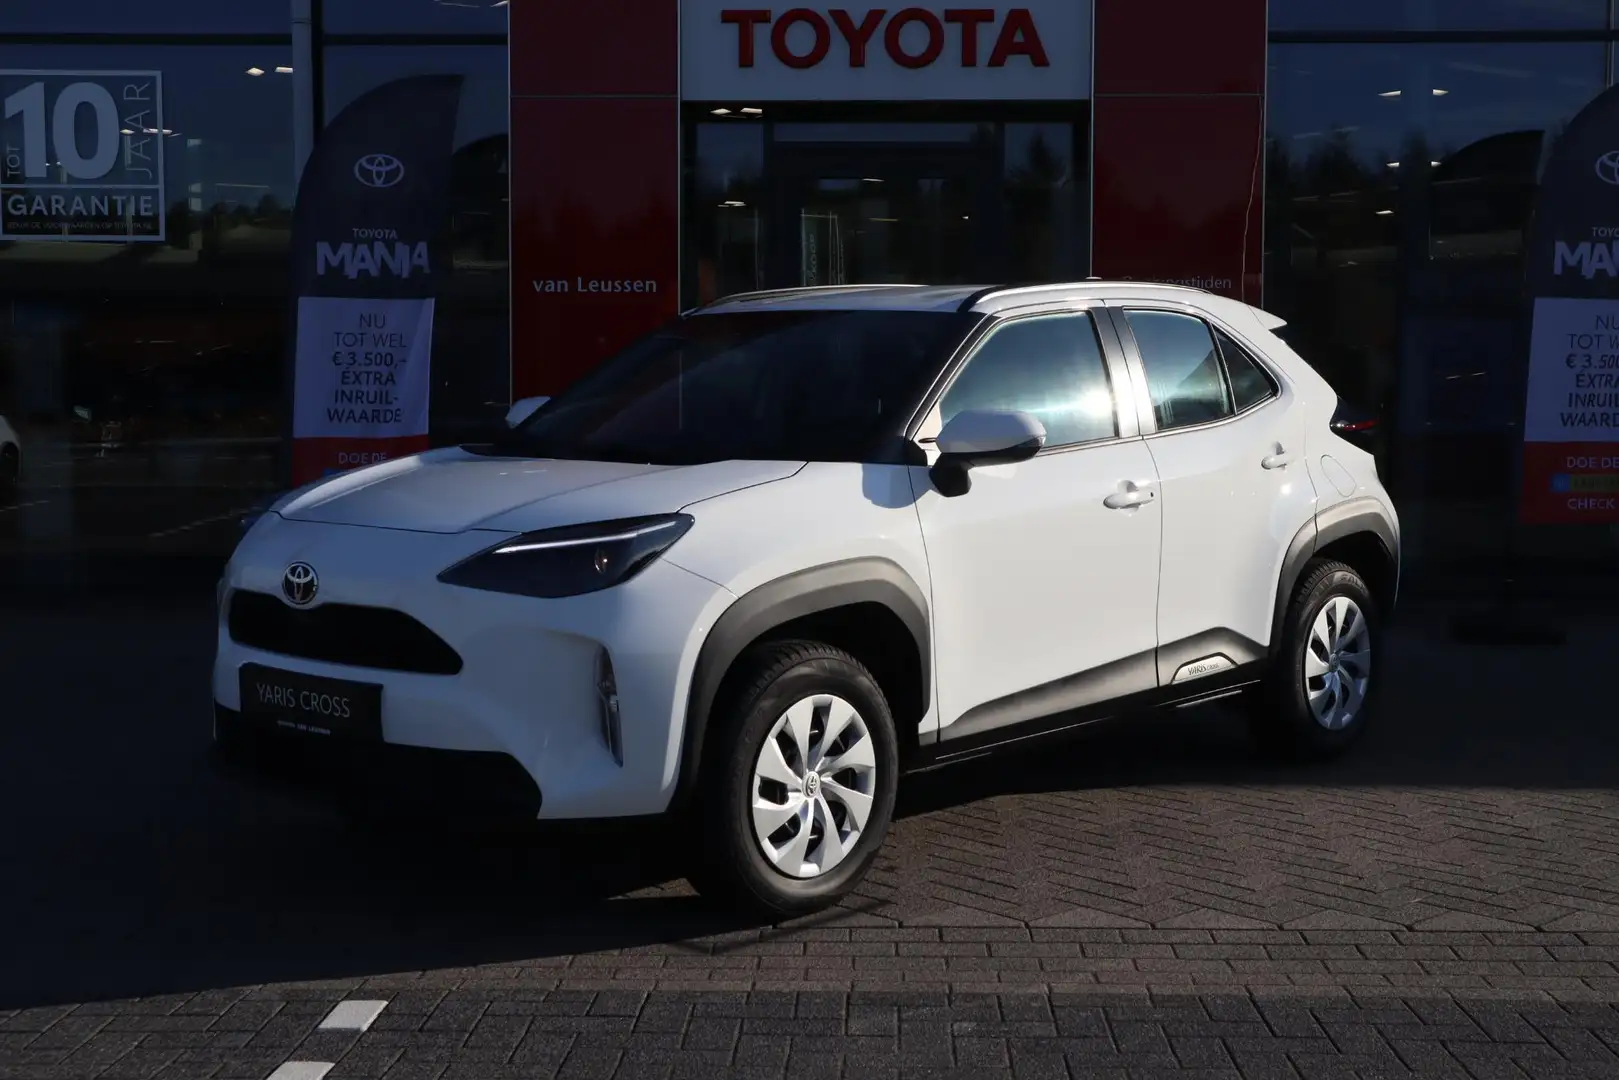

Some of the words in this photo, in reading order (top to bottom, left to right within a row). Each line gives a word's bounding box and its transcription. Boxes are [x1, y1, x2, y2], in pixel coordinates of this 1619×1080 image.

[721, 8, 1050, 69] TOYOTA
[4, 81, 120, 180] 10
[123, 81, 153, 180] JAAR
[6, 142, 21, 178] TOT
[7, 194, 154, 217] GARANTIE
[351, 228, 398, 240] TOYOTA
[316, 240, 431, 280] MANIA
[1553, 239, 1619, 280] MA
[532, 279, 568, 293] van
[577, 276, 657, 293] Leussen
[359, 313, 386, 329] NU
[334, 331, 368, 348] TOT
[372, 332, 407, 348] WEL
[1565, 333, 1604, 350] TOT
[1565, 353, 1577, 369] €
[334, 389, 399, 405] INRUIL-
[326, 407, 402, 424] WAARDE
[338, 452, 369, 465] DOE
[1566, 456, 1598, 469] DOE
[1601, 456, 1619, 469] DE
[1567, 497, 1616, 510] CHECK
[256, 682, 296, 708] YARIS
[300, 690, 351, 718] CROSS
